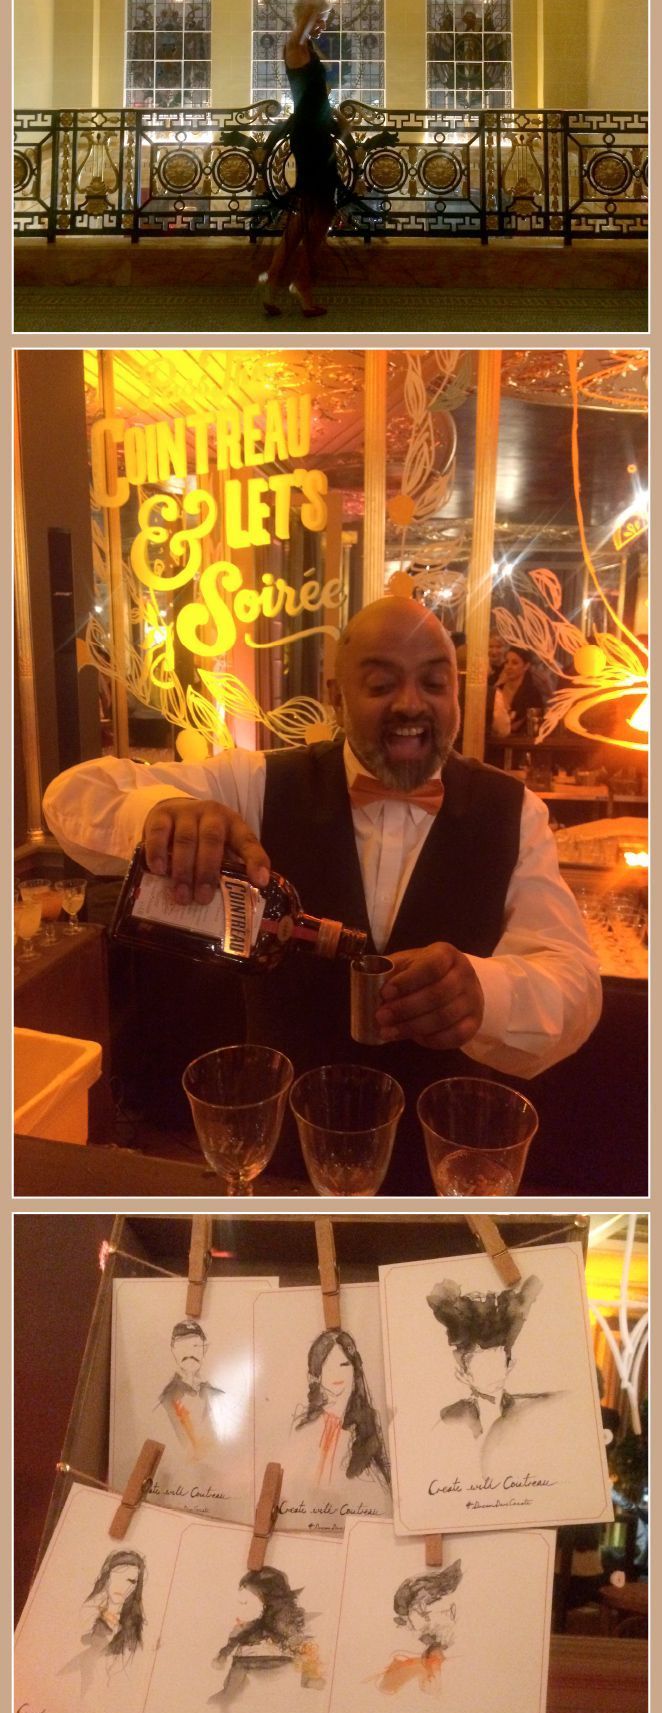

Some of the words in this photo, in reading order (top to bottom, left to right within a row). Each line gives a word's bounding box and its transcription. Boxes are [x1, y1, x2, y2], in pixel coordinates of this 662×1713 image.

[90, 394, 312, 508] COINTREAU
[224, 468, 328, 549] LET'S
[176, 560, 348, 657] Soirée
[224, 880, 246, 954] COINTREAU
[278, 1500, 306, 1514] Create
[340, 1502, 384, 1516] Cointreau
[428, 1476, 462, 1496] Create
[503, 1473, 558, 1490] Cointreau
